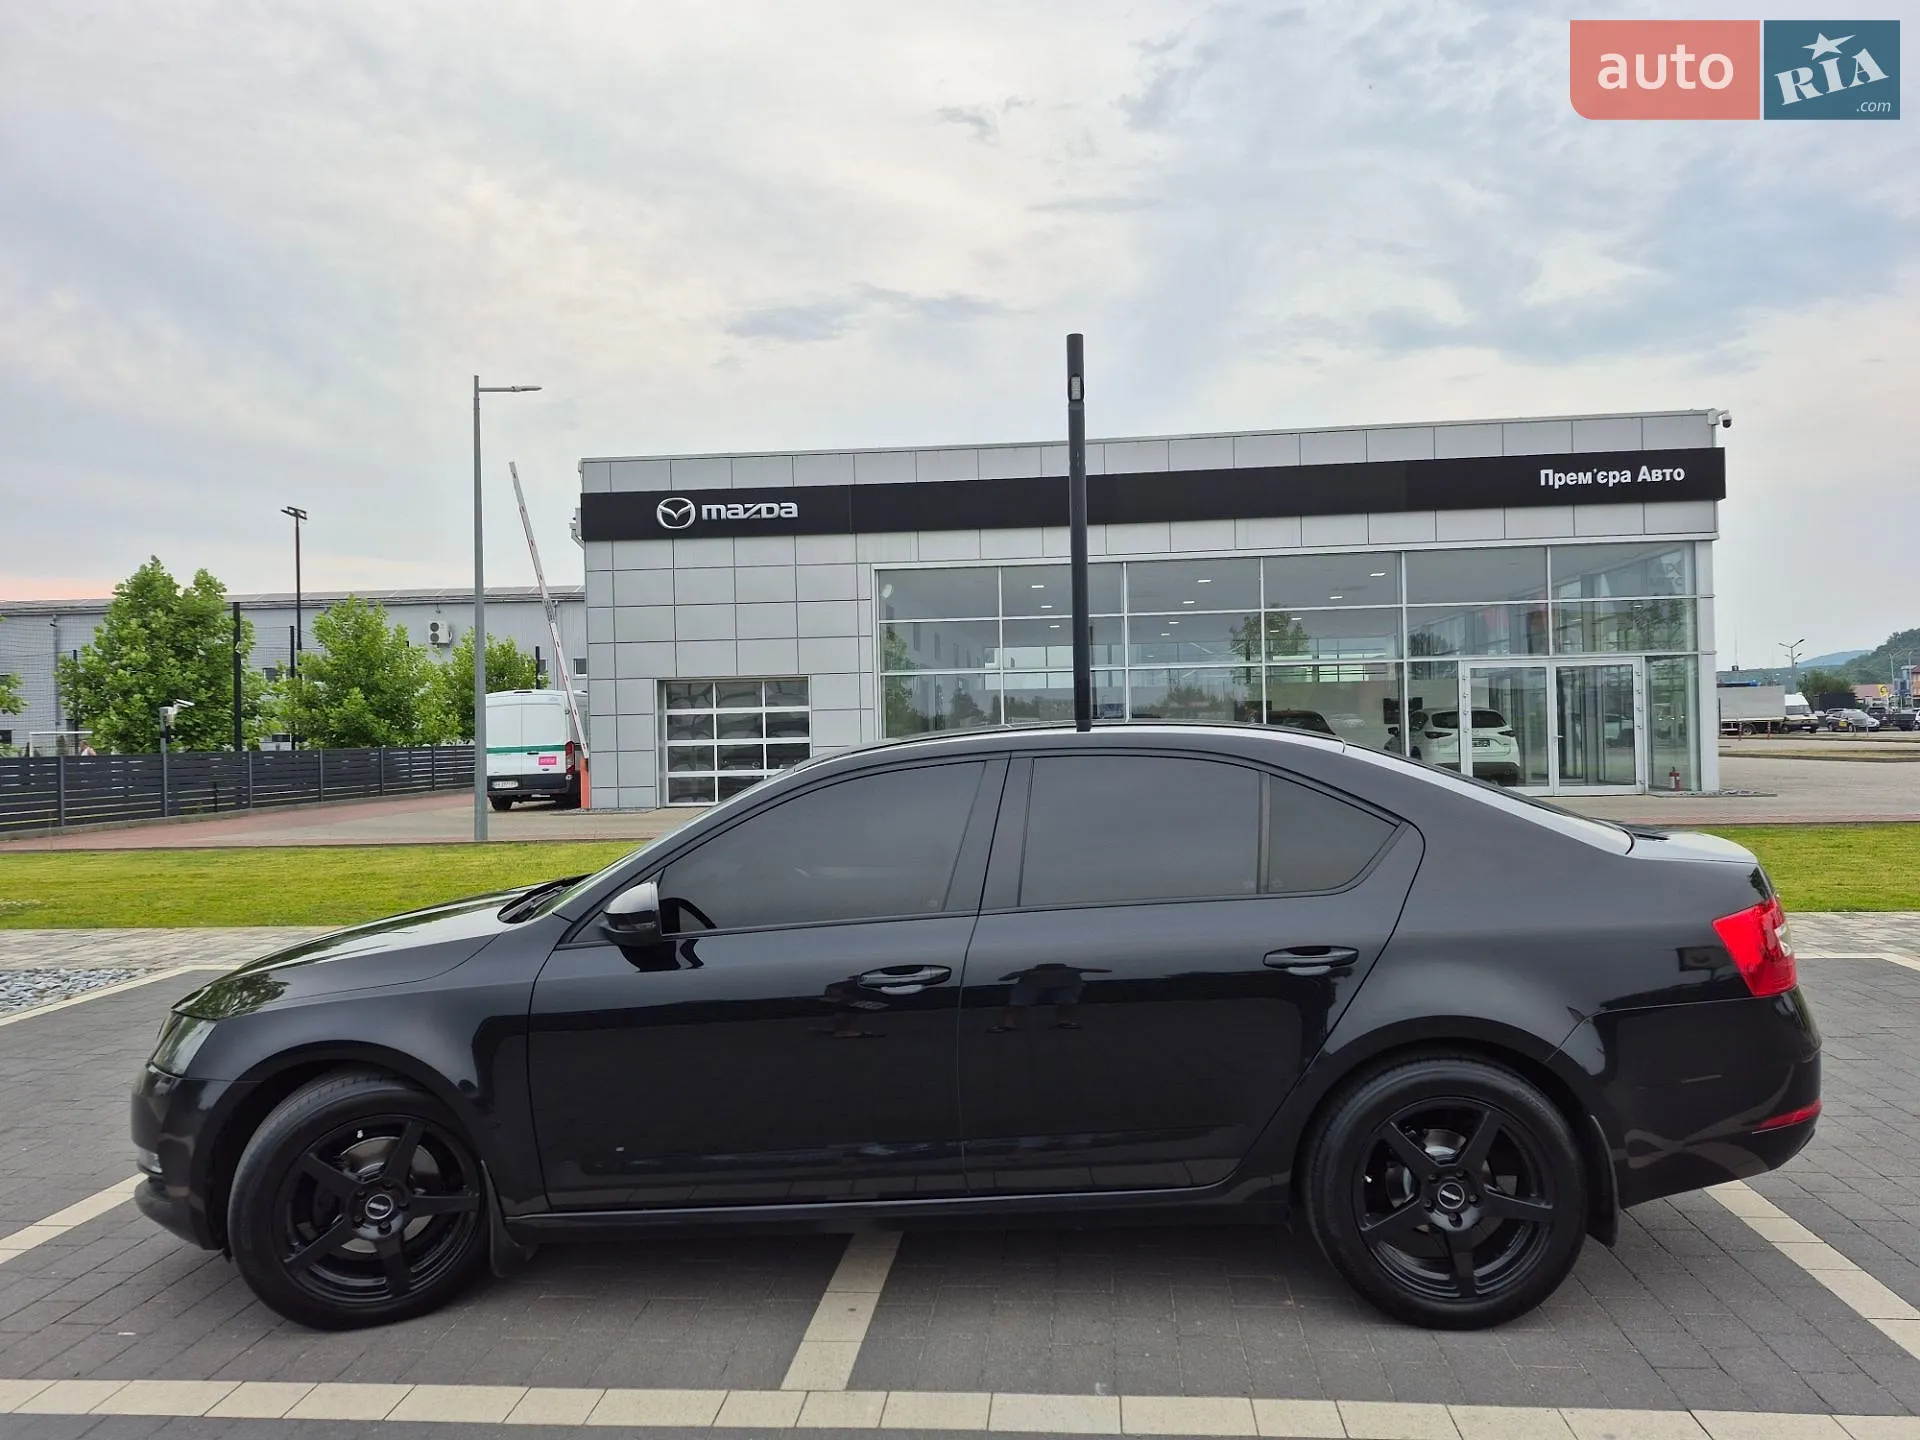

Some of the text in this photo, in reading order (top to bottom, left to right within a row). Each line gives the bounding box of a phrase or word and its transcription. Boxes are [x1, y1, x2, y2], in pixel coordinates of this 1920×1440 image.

[1540, 465, 1686, 489] Прем'єра Авто
[701, 502, 798, 520] mazda
